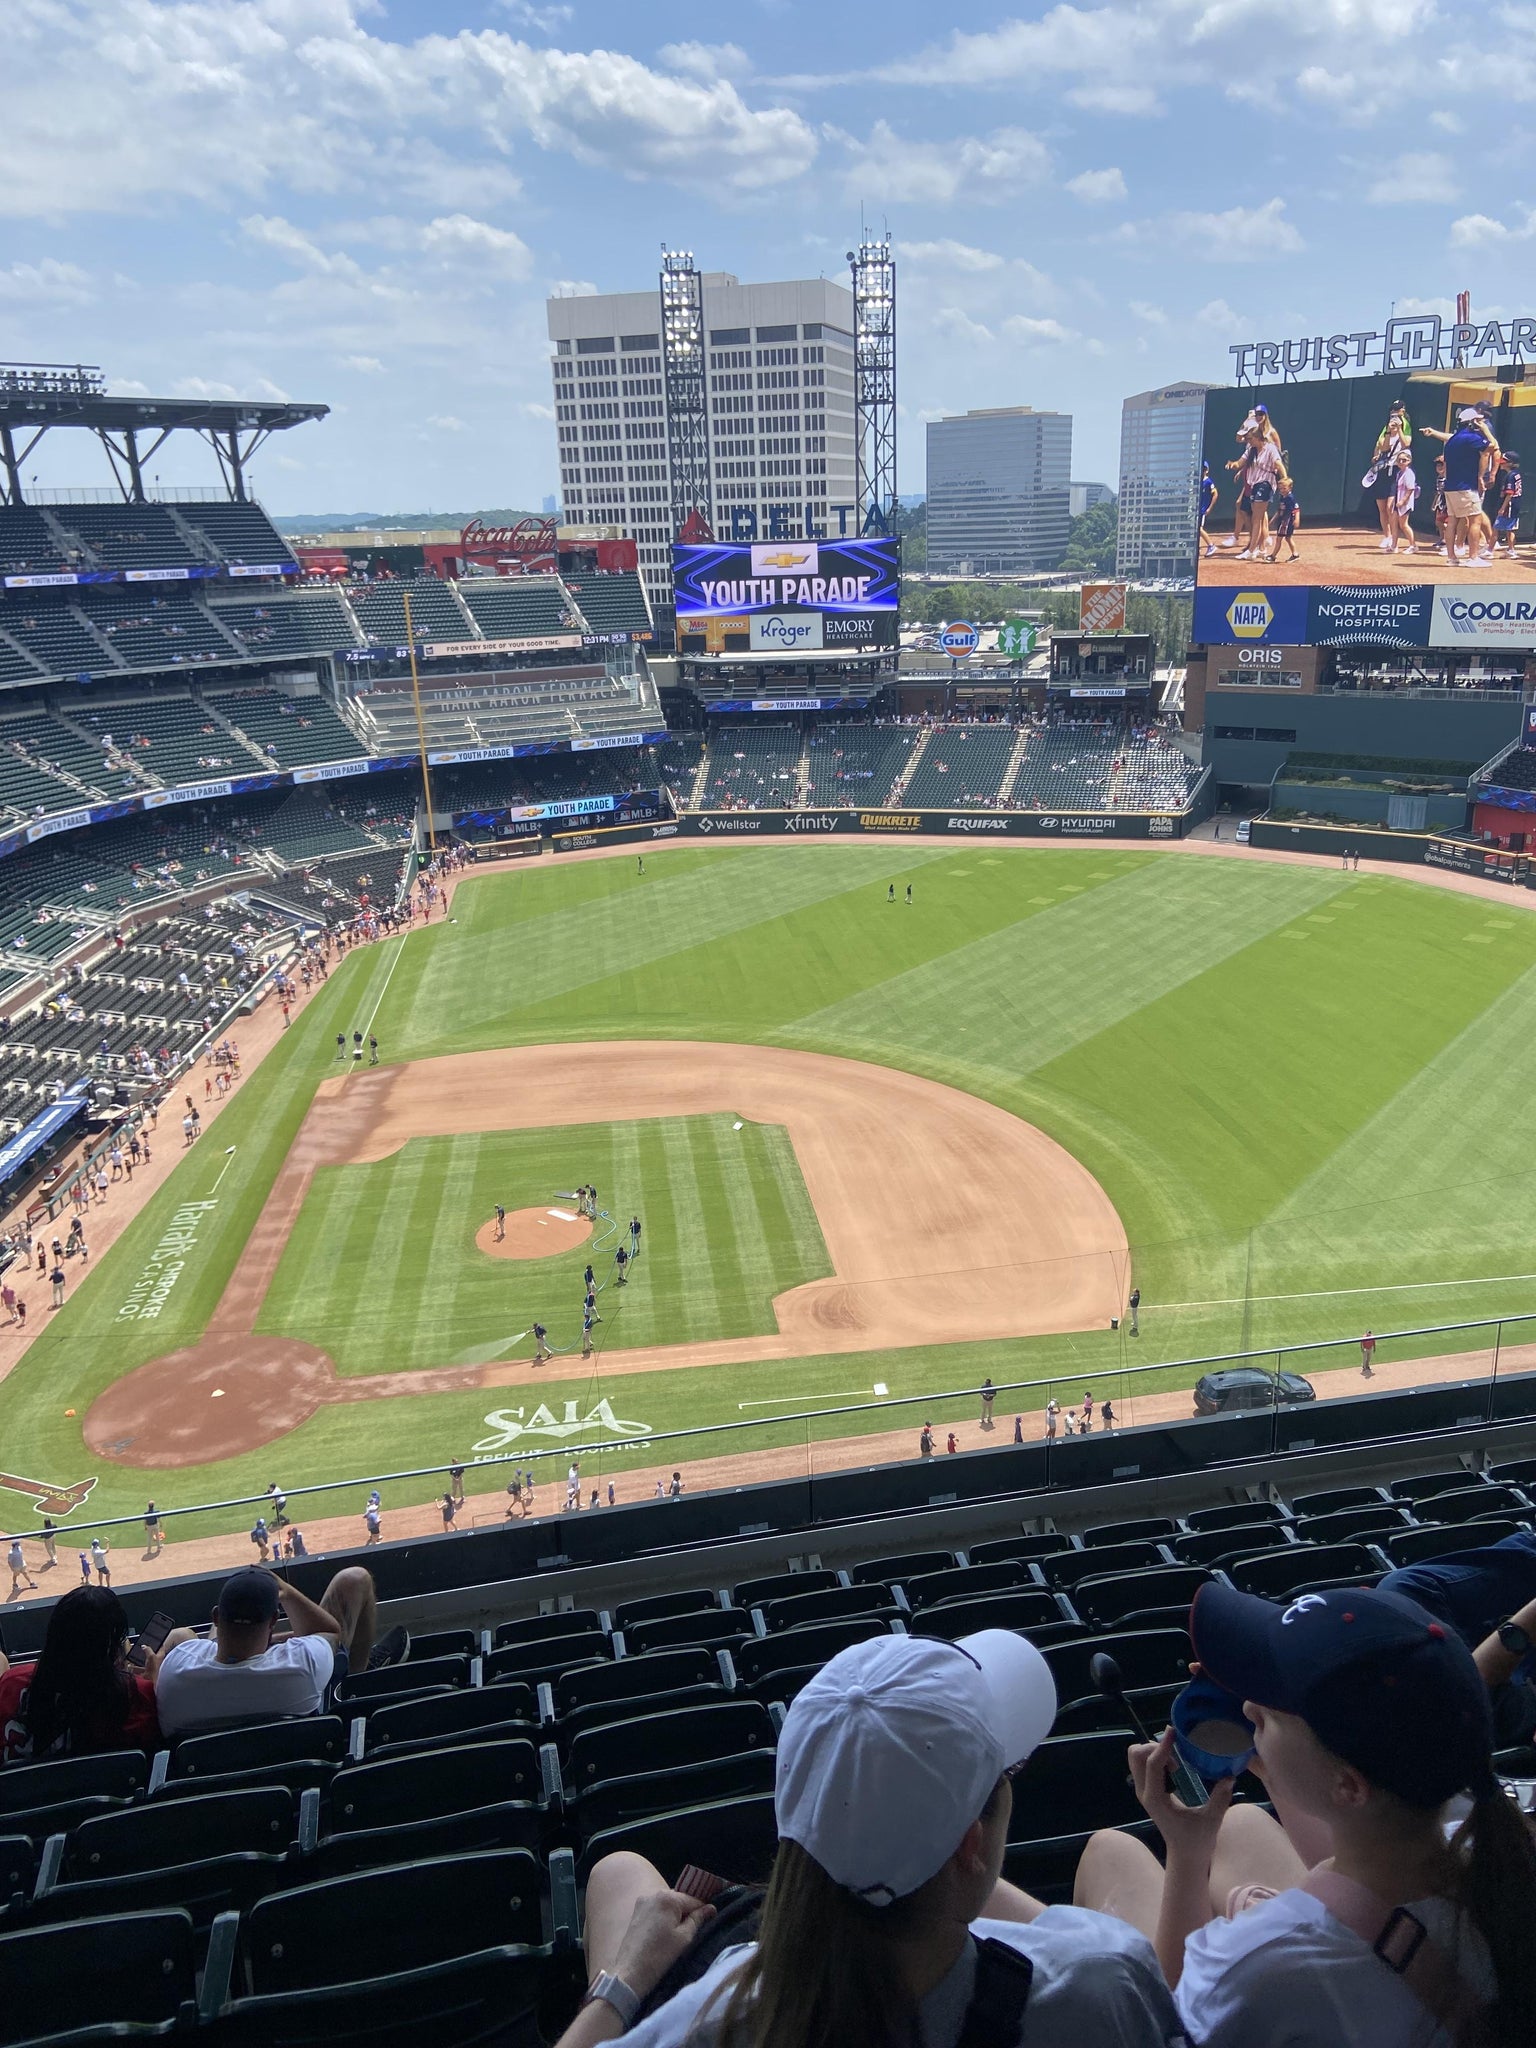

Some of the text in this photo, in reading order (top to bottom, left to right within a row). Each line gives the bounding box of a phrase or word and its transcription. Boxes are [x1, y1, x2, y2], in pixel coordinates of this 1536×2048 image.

[1229, 332, 1377, 378] TRUIST
[1164, 388, 1206, 399] ONEDIGITA
[731, 503, 889, 540] DELTA
[700, 575, 871, 607] YOUTH PARADE
[1086, 589, 1103, 608] THE
[1081, 585, 1126, 629] HOME
[1318, 604, 1421, 617] NORTHSIDE
[1098, 602, 1125, 630] DEPOT
[1234, 605, 1266, 625] NAPA
[826, 620, 875, 633] EMORY
[1335, 618, 1400, 628] HOSPITAL
[760, 617, 812, 646] Kroger
[600, 635, 610, 643] PM
[942, 634, 976, 646] Gulf
[1238, 648, 1282, 663] ORIS
[597, 735, 640, 748] YOUTH PARADE
[458, 748, 510, 760] YOUTH PARADE
[320, 764, 367, 778] YOUTH PARADE
[170, 784, 228, 802] YOUTH PARADE
[547, 799, 610, 816] YOUTH PARADE
[630, 808, 658, 820] MLB+
[63, 814, 89, 828] PARADE
[715, 820, 762, 830] Wellstar
[784, 814, 839, 832] xfinity
[860, 814, 922, 826] QUIKRETE
[948, 818, 1009, 830] EQUIFAX
[1061, 818, 1116, 828] HYUNDAI
[1150, 817, 1173, 826] PAPA
[514, 822, 543, 834] MLB+
[115, 1262, 163, 1324] CASINOS
[138, 1260, 186, 1320] CHEROKEE
[471, 1397, 653, 1451] SAIA
